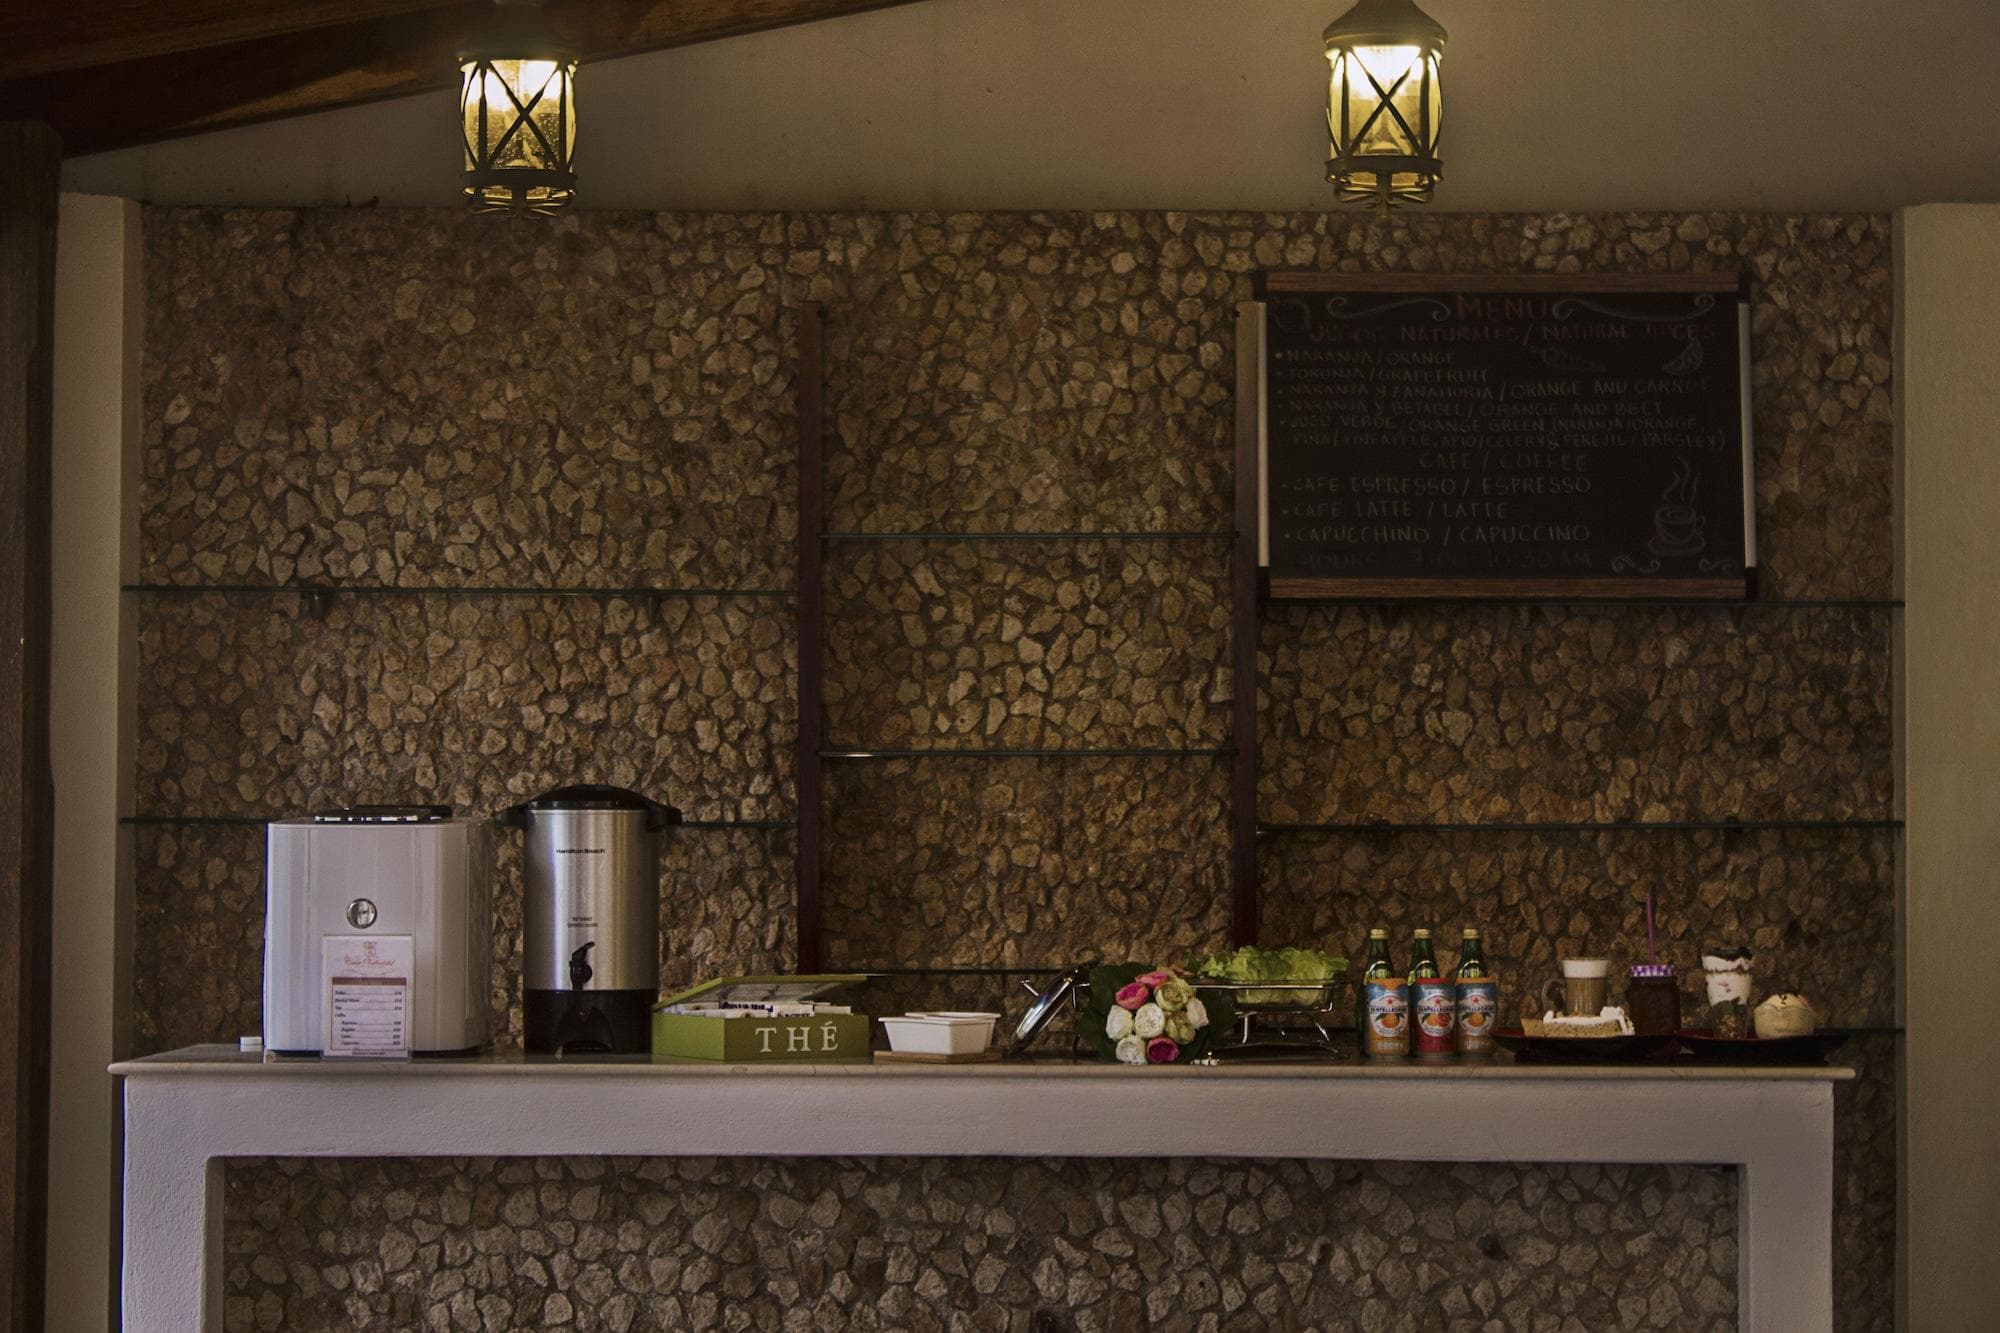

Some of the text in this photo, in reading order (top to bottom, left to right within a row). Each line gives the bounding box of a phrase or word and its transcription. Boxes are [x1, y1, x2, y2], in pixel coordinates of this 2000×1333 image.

[1455, 296, 1548, 321] MENU
[1594, 379, 1629, 395] AND
[1569, 401, 1609, 416] AND
[1499, 453, 1592, 472] COFFEE
[1293, 476, 1340, 493] CAFE
[1350, 475, 1456, 496] ESPRESSO
[1482, 476, 1592, 496] ESPRESSO
[1293, 501, 1344, 519] CAFE
[1356, 500, 1412, 518] LATTE
[1443, 501, 1510, 518] LATTE
[1296, 525, 1431, 544] CAPUCCHINO
[1459, 524, 1592, 544] CAPUCCINO
[754, 1020, 840, 1054] THÉ
